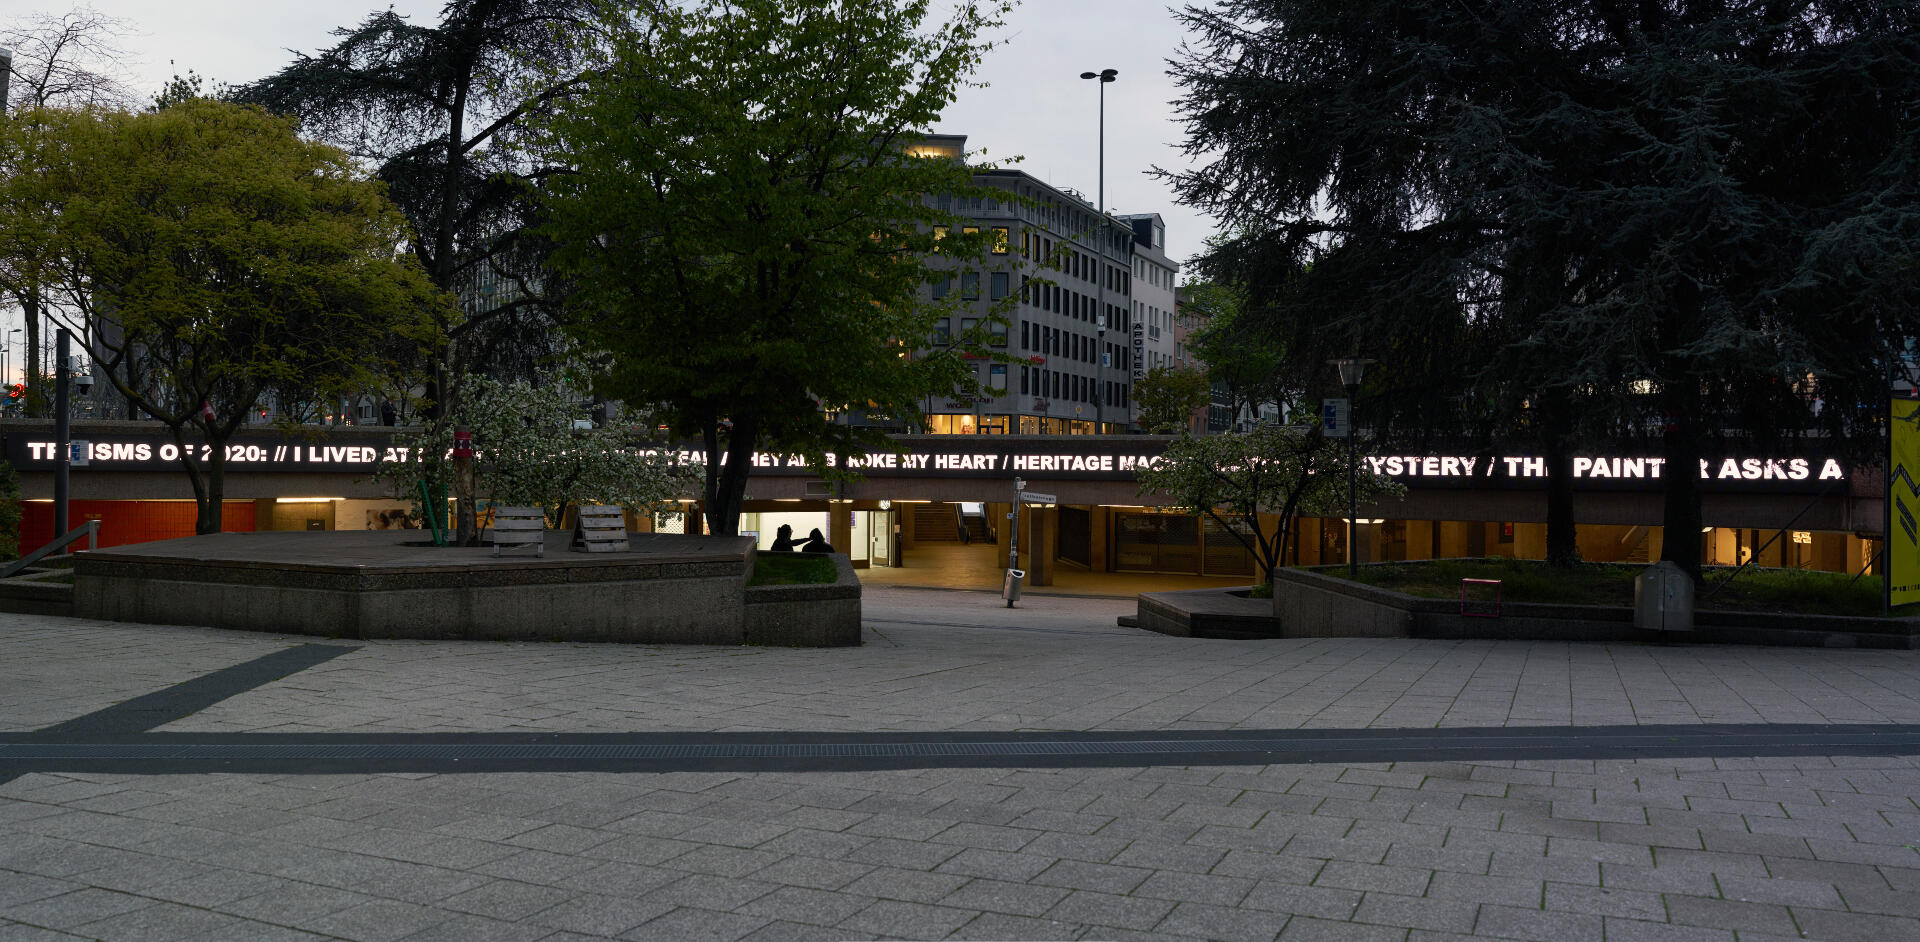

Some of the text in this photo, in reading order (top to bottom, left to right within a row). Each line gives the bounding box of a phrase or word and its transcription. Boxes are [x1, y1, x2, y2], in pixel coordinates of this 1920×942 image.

[295, 447, 300, 461] I
[309, 447, 376, 462] LIVED
[383, 448, 410, 462] AT
[903, 454, 930, 468] MY
[936, 455, 997, 469] HEART
[1014, 456, 1112, 470] HERITAGE
[1362, 456, 1476, 475] YSTERY
[1504, 457, 1547, 476] TH
[1718, 459, 1809, 479] ASKS
